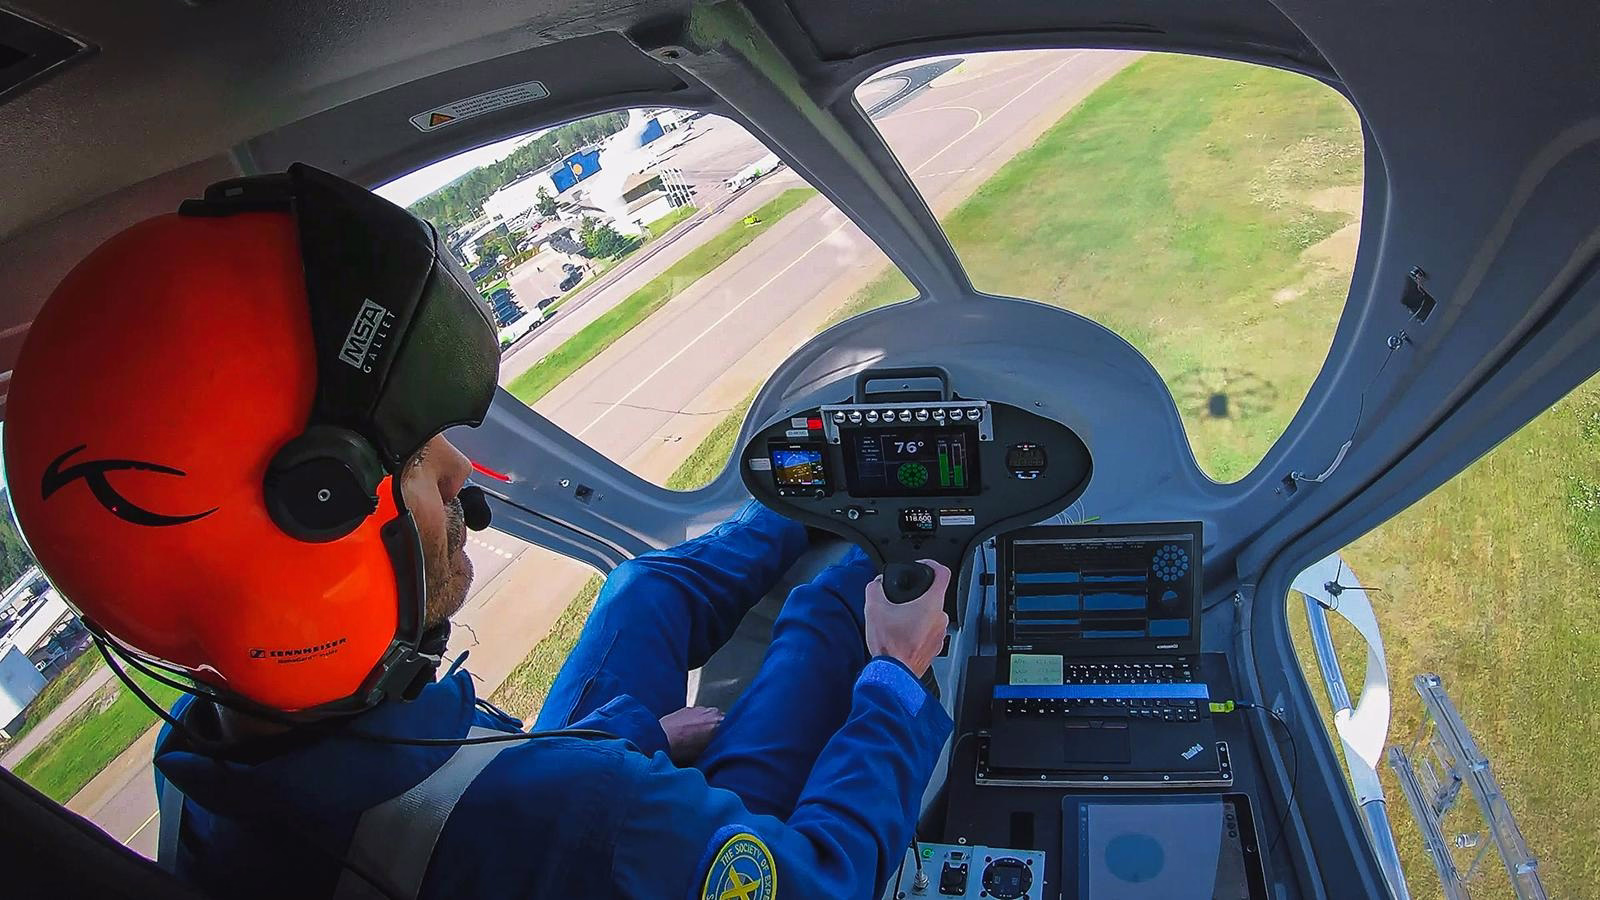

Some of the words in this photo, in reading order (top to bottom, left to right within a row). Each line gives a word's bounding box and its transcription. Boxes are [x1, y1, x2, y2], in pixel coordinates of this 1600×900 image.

[342, 305, 384, 365] MSA
[363, 311, 395, 373] GALLET
[270, 637, 347, 657] SENNHEISER
[720, 848, 735, 866] THE
[734, 842, 763, 860] SOCIETY
[760, 859, 770, 871] OF
